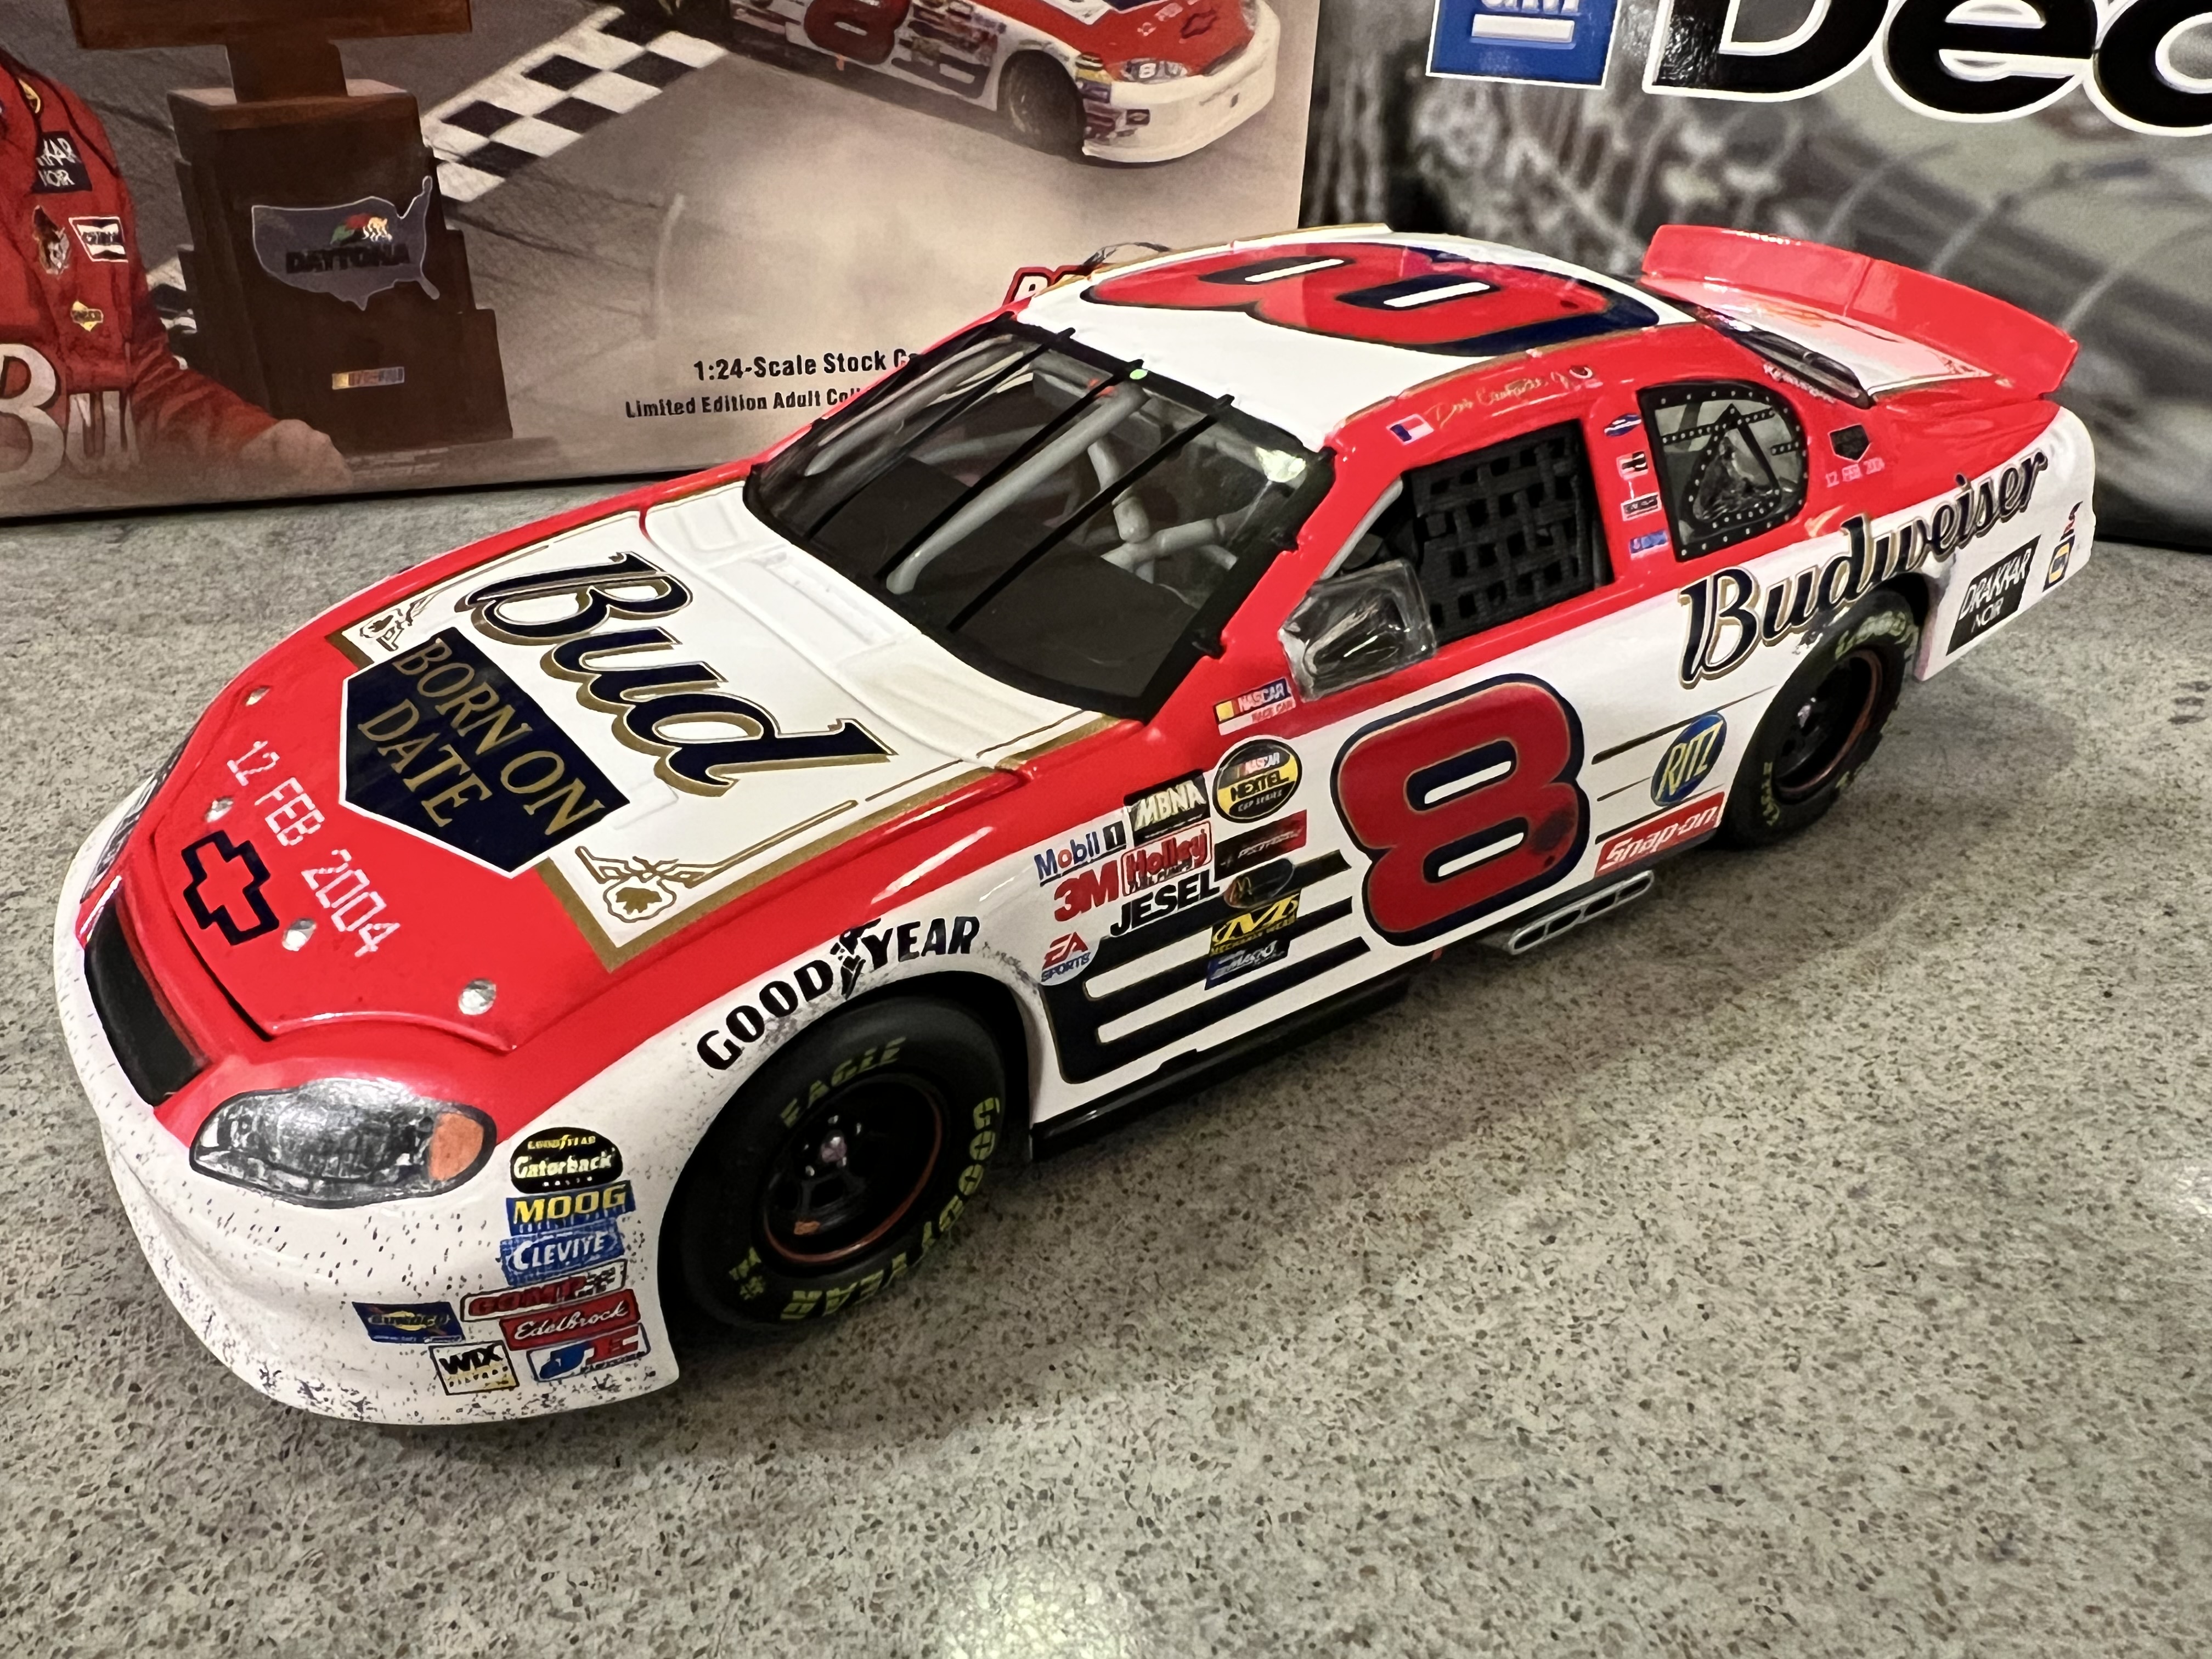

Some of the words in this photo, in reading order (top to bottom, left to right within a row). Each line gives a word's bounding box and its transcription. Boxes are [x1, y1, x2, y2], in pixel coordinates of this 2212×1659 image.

[1080, 241, 1660, 358] 8
[693, 354, 817, 381] 1:24-Scale
[823, 350, 885, 374] Stock
[625, 396, 696, 418] Limited
[702, 394, 768, 413] Edition
[773, 391, 821, 409] Adult
[1678, 448, 2048, 690] Budweiser
[1958, 548, 2032, 620] DRAKKAR
[454, 551, 899, 798] Bud
[1238, 682, 1285, 713] NASCAR
[357, 699, 492, 827] DATE
[392, 638, 532, 755] BORN
[500, 749, 605, 836] ON
[1655, 720, 1724, 801] RITZ
[1135, 779, 1207, 832] MBNA
[1230, 770, 1290, 802] NEXTEL
[1330, 673, 1590, 946] 8
[227, 740, 280, 786] 12
[254, 777, 325, 847] FEB
[301, 849, 401, 958] 2004
[1034, 831, 1101, 882] Mobil
[1126, 828, 1207, 885] Holley
[1598, 806, 1719, 871] Snap-on
[1054, 859, 1119, 922] 3M
[1110, 869, 1221, 936] JESEL
[1041, 951, 1091, 982] SPORTS
[514, 1150, 613, 1179] Gatorback
[514, 1183, 627, 1224] MOOG
[513, 1231, 608, 1271] CLEVITE
[514, 1302, 629, 1341] Edelbrock
[438, 1344, 504, 1375] WIX
